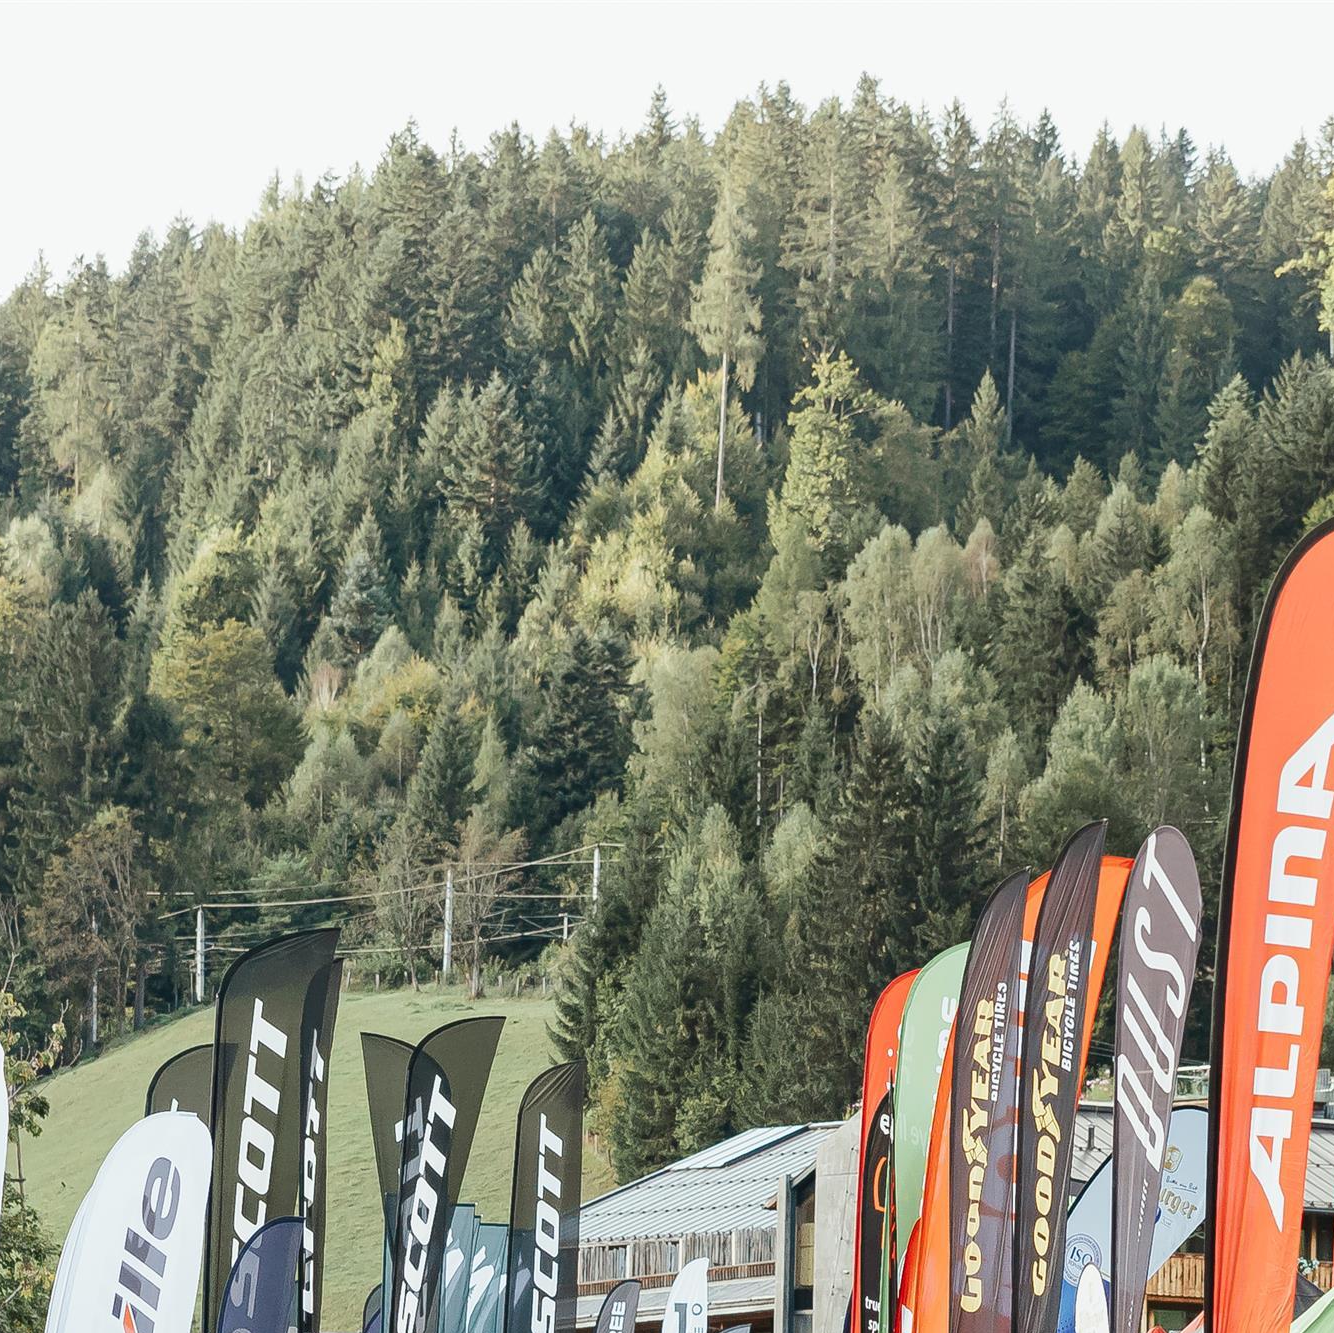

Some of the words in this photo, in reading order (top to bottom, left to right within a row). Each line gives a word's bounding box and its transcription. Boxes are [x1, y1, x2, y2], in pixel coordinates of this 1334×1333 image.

[1067, 939, 1081, 992] TIRES
[1116, 833, 1197, 1173] DUST
[996, 982, 1008, 1031] TIRES
[1061, 995, 1076, 1073] BICYCLE
[991, 1032, 1005, 1102] BICYCLE
[961, 996, 994, 1312] GOODYEAR
[1032, 952, 1068, 1297] GOODYEAR
